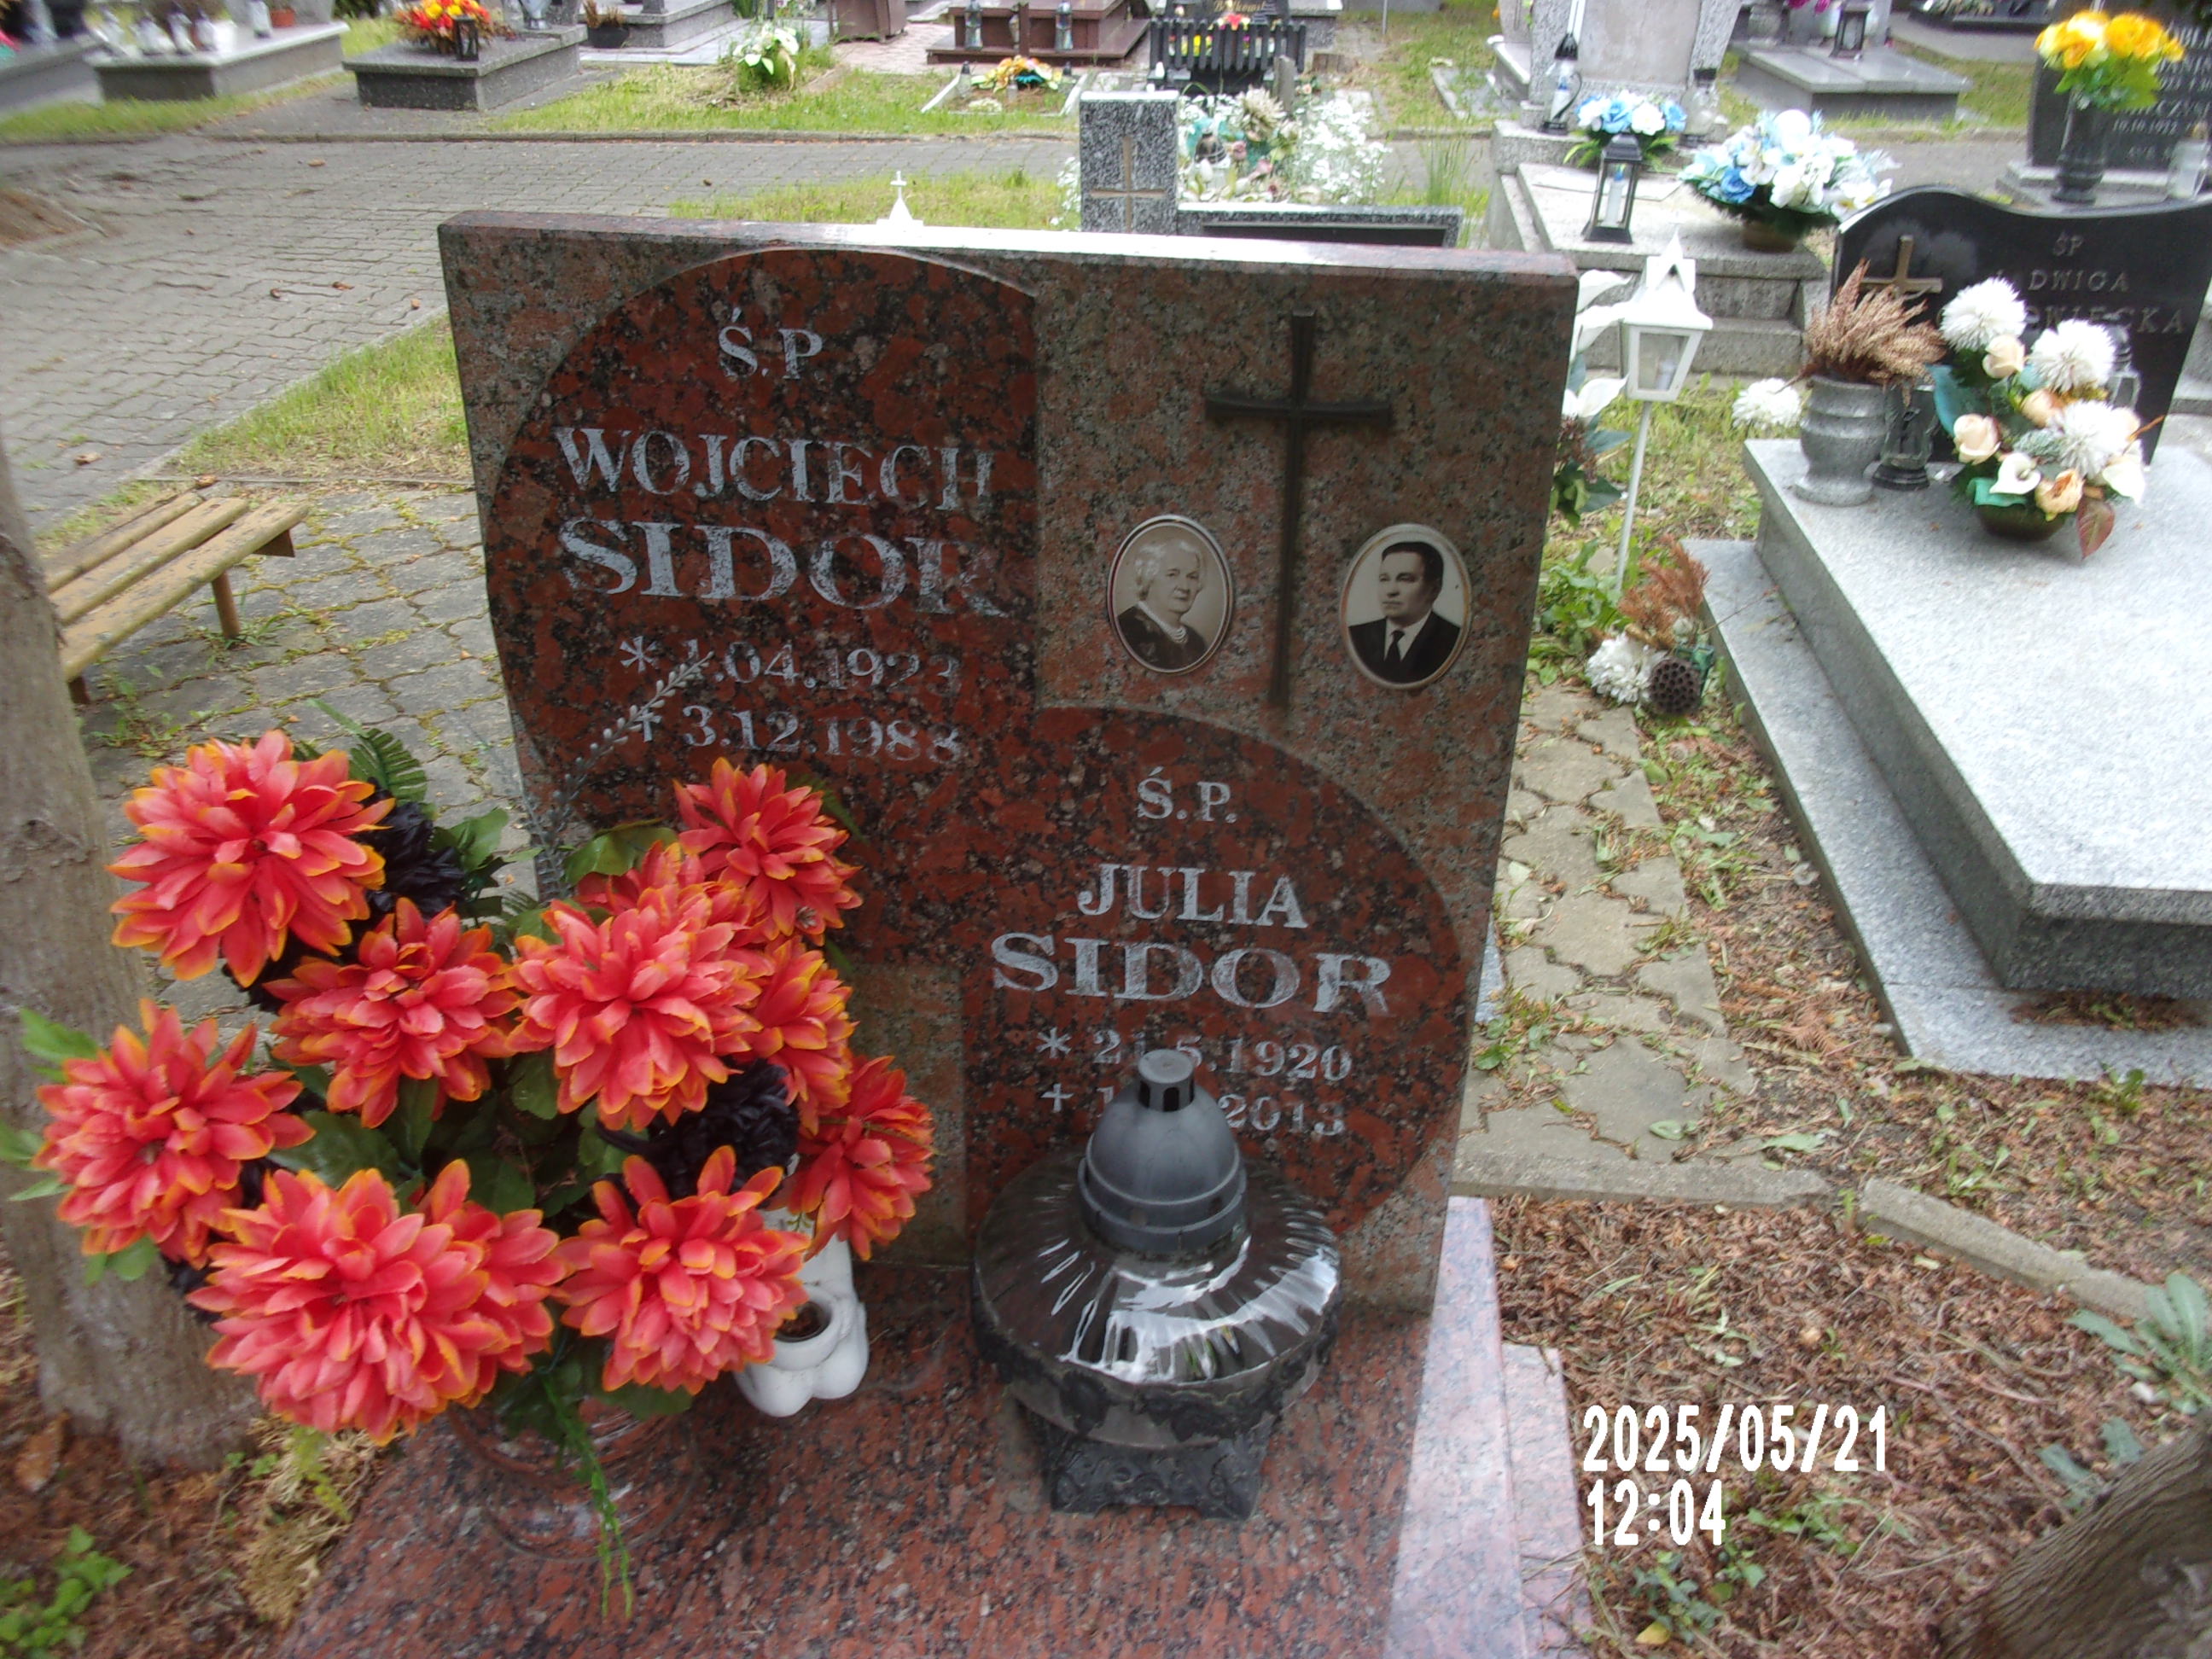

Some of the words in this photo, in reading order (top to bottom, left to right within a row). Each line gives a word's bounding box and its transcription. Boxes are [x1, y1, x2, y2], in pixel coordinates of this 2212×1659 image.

[1995, 269, 2130, 293] DWIGA
[554, 426, 997, 512] WOJCIECH
[558, 516, 1010, 619] SIDOR
[682, 704, 966, 764] 3.12.1988
[1138, 766, 1238, 824] Ś.P.
[1077, 862, 1309, 929] JULIA
[990, 931, 1394, 1017] SIDOR
[1092, 1028, 1353, 1082] 215.1920
